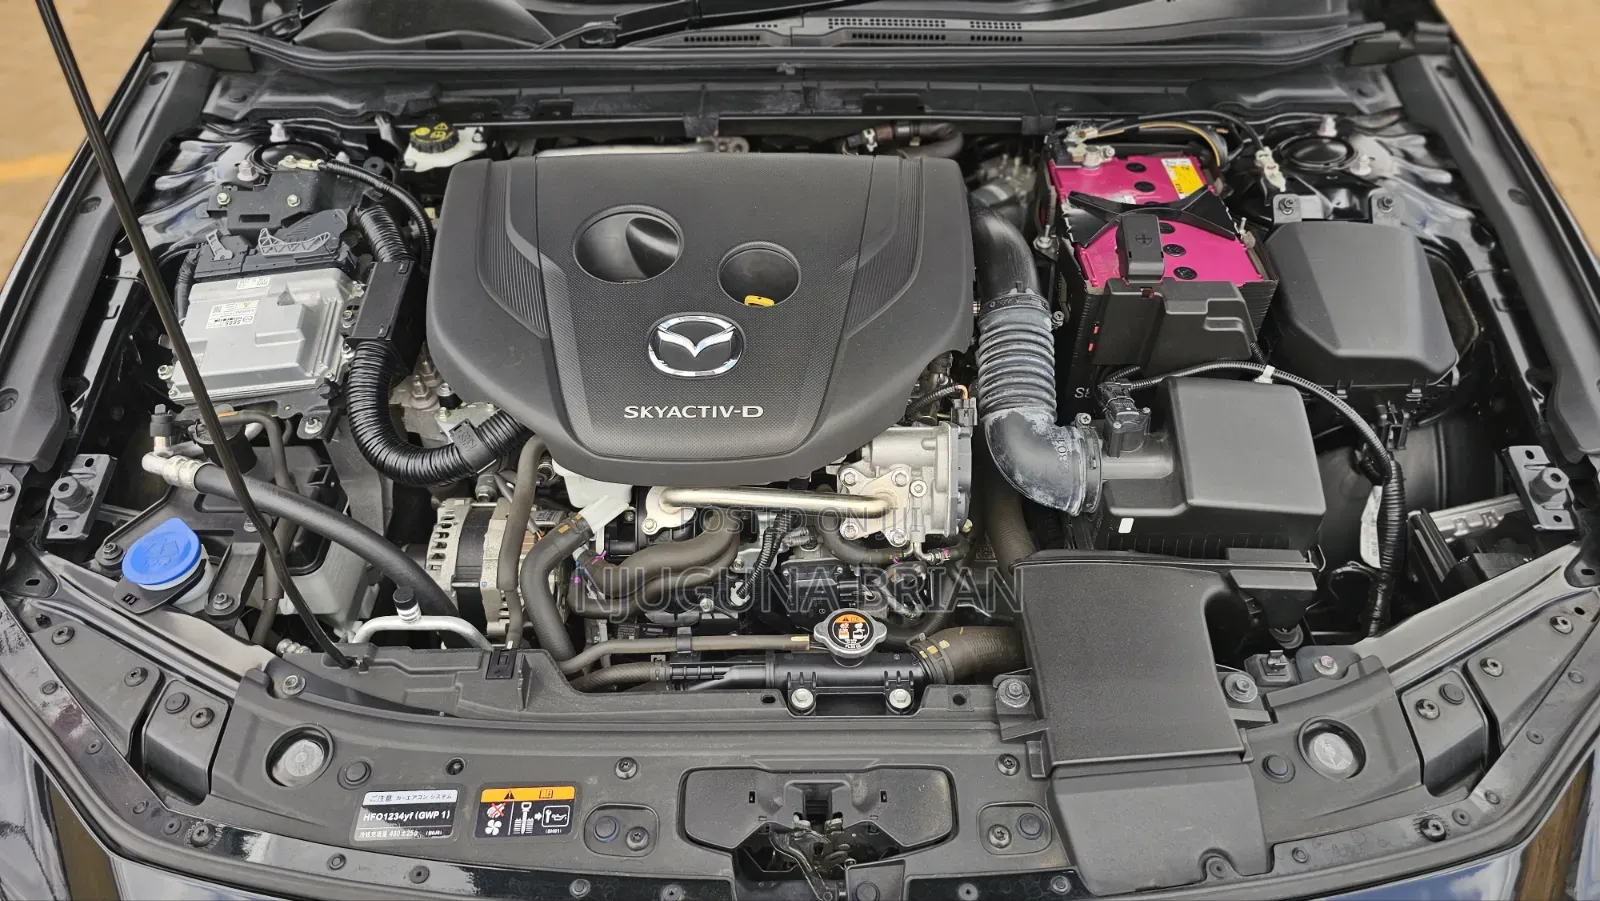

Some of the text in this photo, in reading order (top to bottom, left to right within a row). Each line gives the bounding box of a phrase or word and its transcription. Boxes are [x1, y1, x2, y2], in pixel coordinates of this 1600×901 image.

[623, 405, 764, 418] SKYACTIV-D
[363, 809, 451, 822] HFO1234yf (GWP 1)
